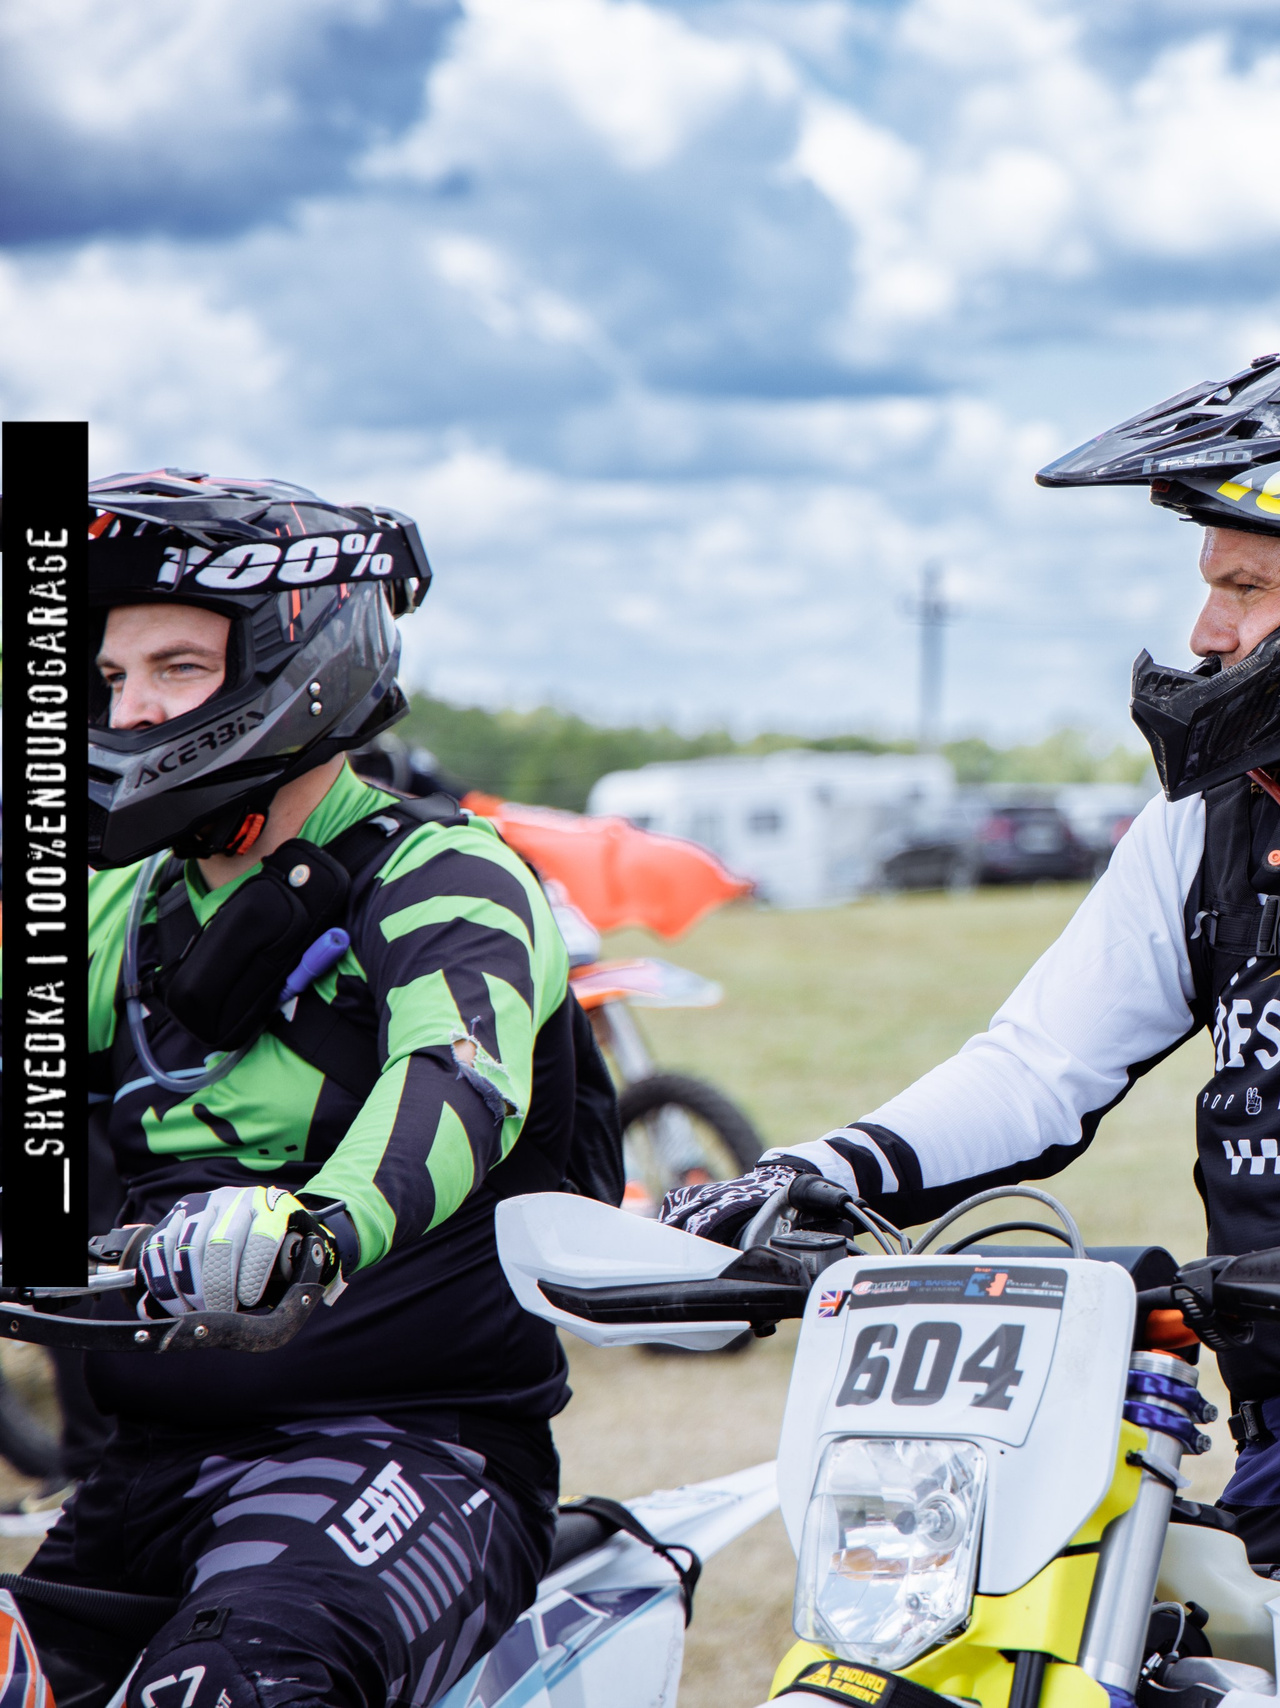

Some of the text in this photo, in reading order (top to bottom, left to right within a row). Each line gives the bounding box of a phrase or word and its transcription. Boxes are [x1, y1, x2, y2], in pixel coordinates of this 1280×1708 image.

[1202, 1092, 1235, 1110] POP
[836, 1321, 1025, 1411] 604
[325, 1460, 425, 1567] LEATT
[827, 1679, 882, 1705] ELEMENT
[831, 1665, 888, 1694] ENDURO
